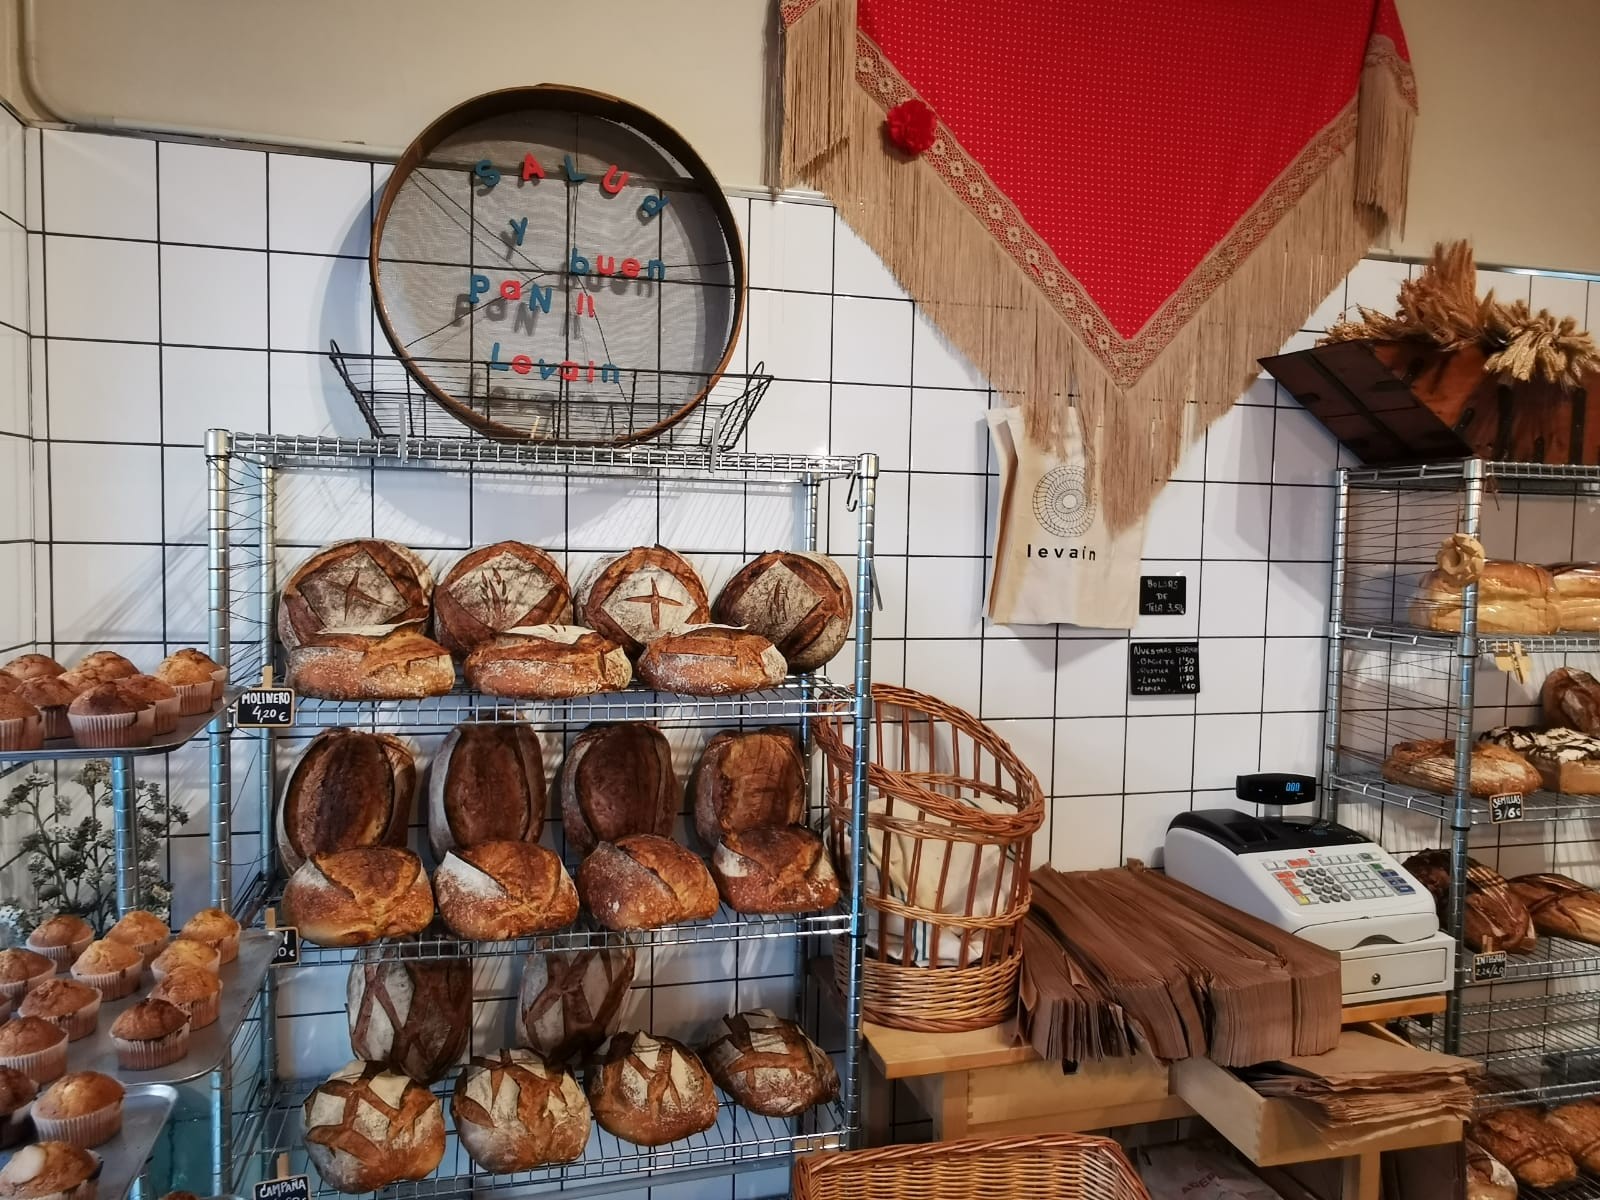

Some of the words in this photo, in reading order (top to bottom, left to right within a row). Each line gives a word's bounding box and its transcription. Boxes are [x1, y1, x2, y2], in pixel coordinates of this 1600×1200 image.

[571, 247, 665, 282] buen
[491, 342, 620, 384] Levain
[1026, 543, 1097, 561] levain
[242, 693, 290, 704] MOLINERO
[260, 1179, 306, 1198] CAMPAÑA
